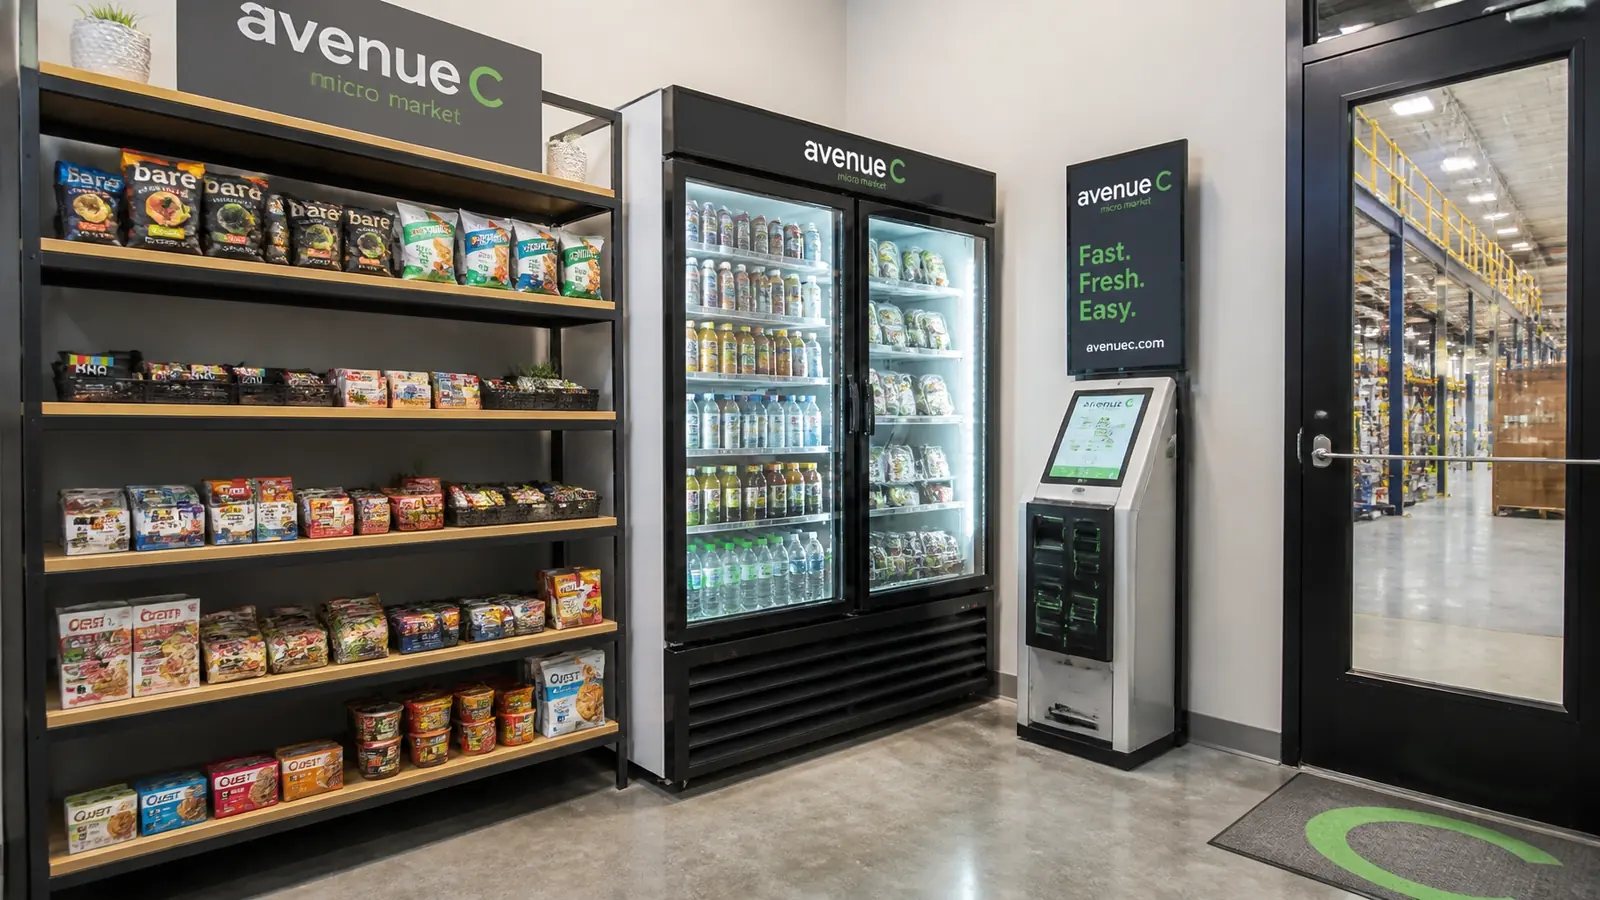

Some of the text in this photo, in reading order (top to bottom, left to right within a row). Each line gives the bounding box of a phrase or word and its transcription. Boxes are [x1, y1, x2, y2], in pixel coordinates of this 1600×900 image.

[237, 2, 504, 108] avenue C
[310, 71, 461, 125] micro market
[804, 140, 906, 184] avenue C
[134, 162, 196, 189] bare
[837, 173, 860, 185] micro
[1077, 170, 1172, 206] avenue C
[347, 210, 391, 230] bare
[1100, 202, 1123, 213] micro
[1079, 242, 1131, 266] Fast.
[1079, 268, 1145, 294] Fresh.
[1080, 300, 1136, 323] Easy.
[1086, 338, 1165, 352] avenuec.com
